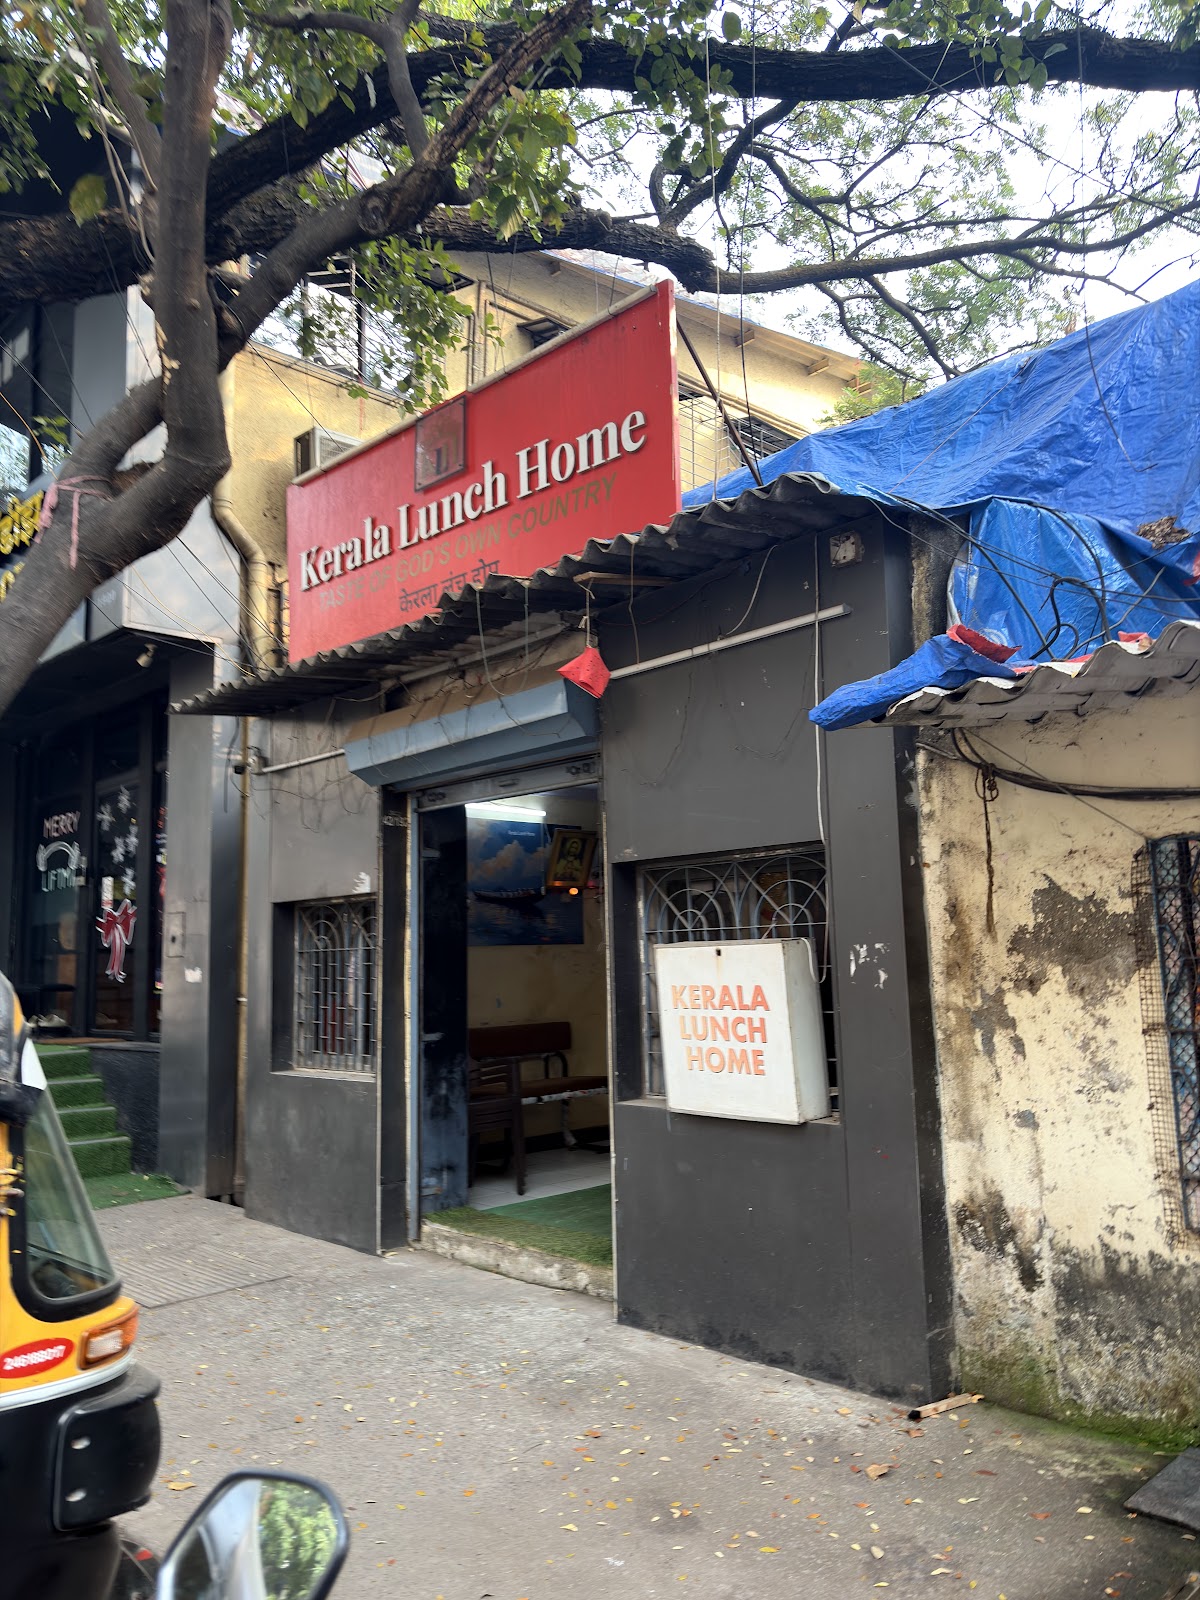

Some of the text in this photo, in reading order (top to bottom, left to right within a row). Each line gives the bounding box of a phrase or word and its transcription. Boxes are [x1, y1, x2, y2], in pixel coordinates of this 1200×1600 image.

[299, 409, 647, 593] Kerala Lunch Home
[319, 472, 618, 613] TASTE OF GOD'S OWN COUNTRY
[43, 811, 81, 838] MERRY
[671, 984, 770, 1011] KERALA
[679, 1015, 768, 1043] LUNCH
[686, 1045, 766, 1076] HOME
